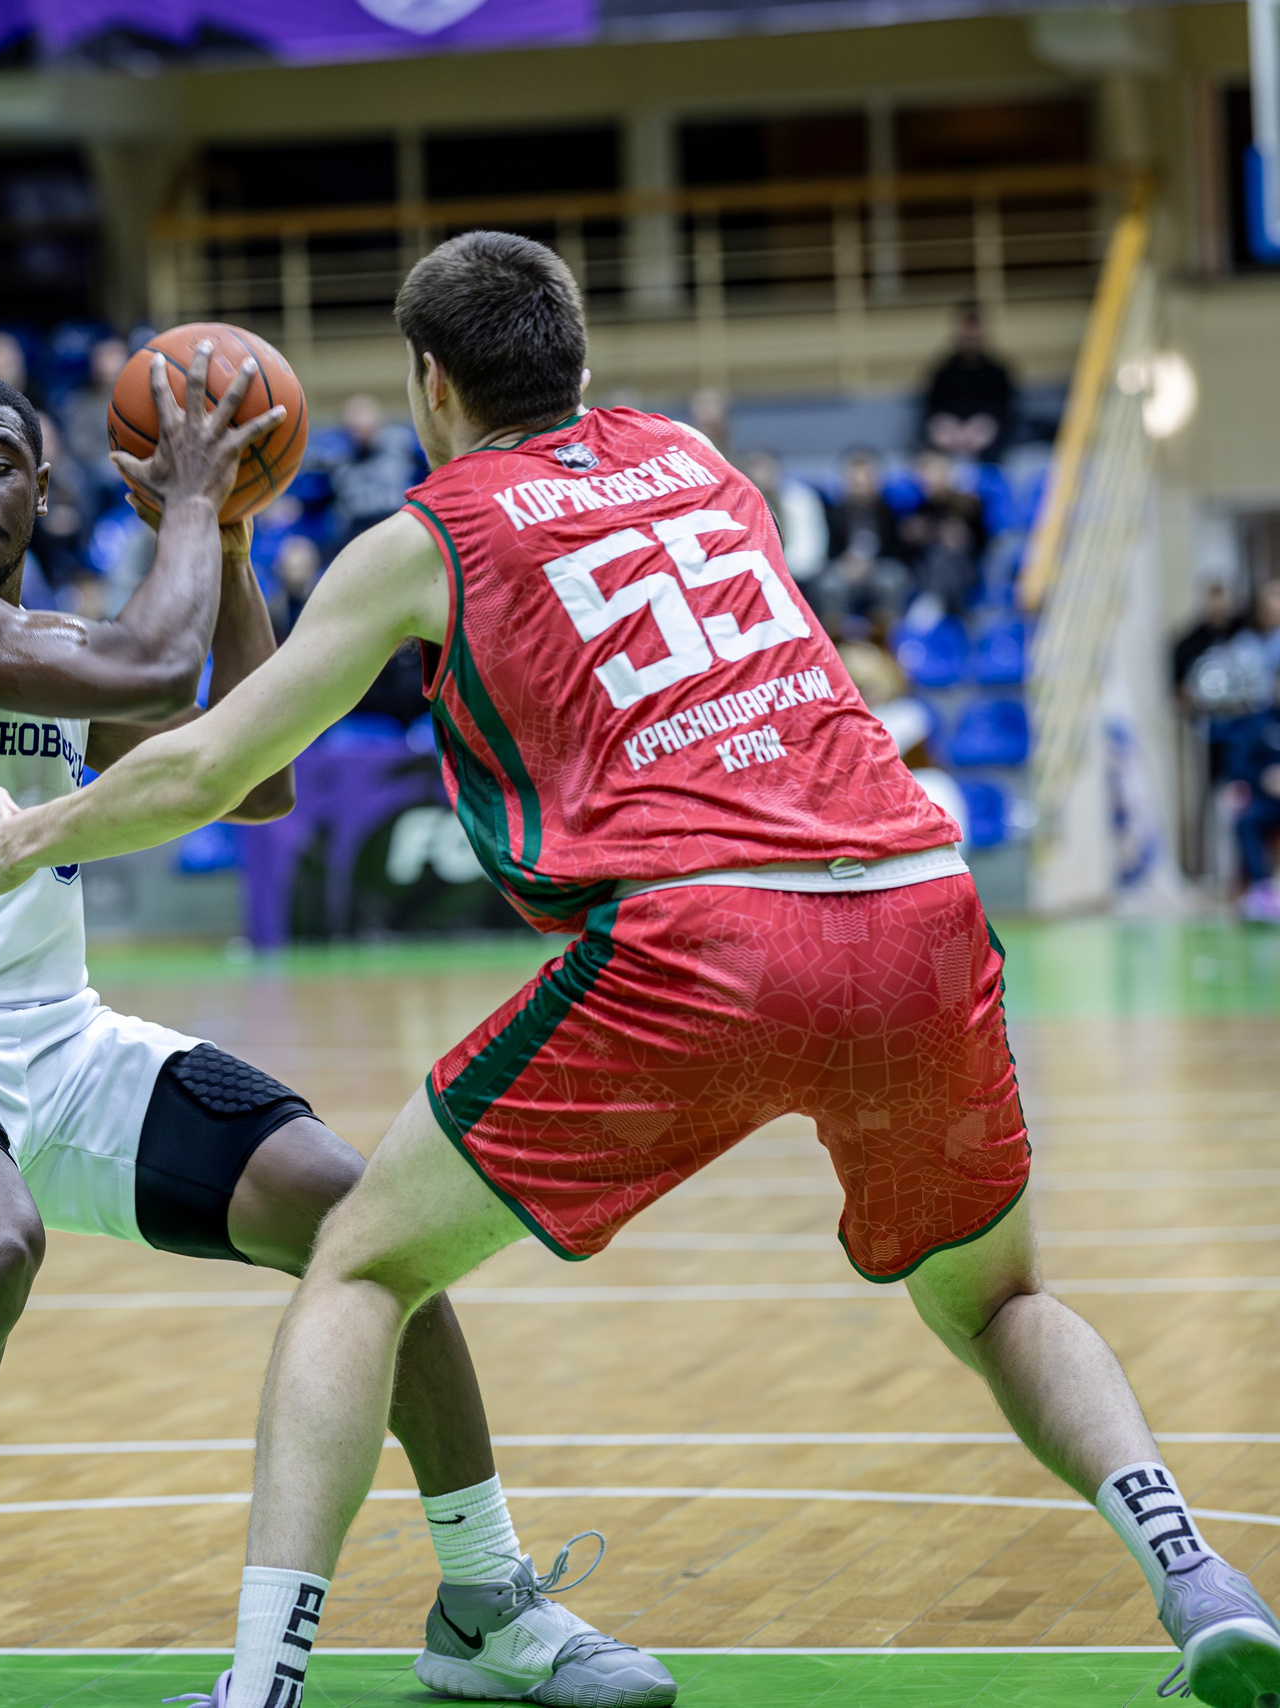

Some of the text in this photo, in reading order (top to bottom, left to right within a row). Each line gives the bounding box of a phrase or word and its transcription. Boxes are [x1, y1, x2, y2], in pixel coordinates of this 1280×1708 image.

[542, 509, 811, 710] 55
[623, 666, 835, 771] КРАСНОДАРСКИЙ
[715, 725, 788, 774] КРАЙ
[1112, 1468, 1201, 1572] ELITE
